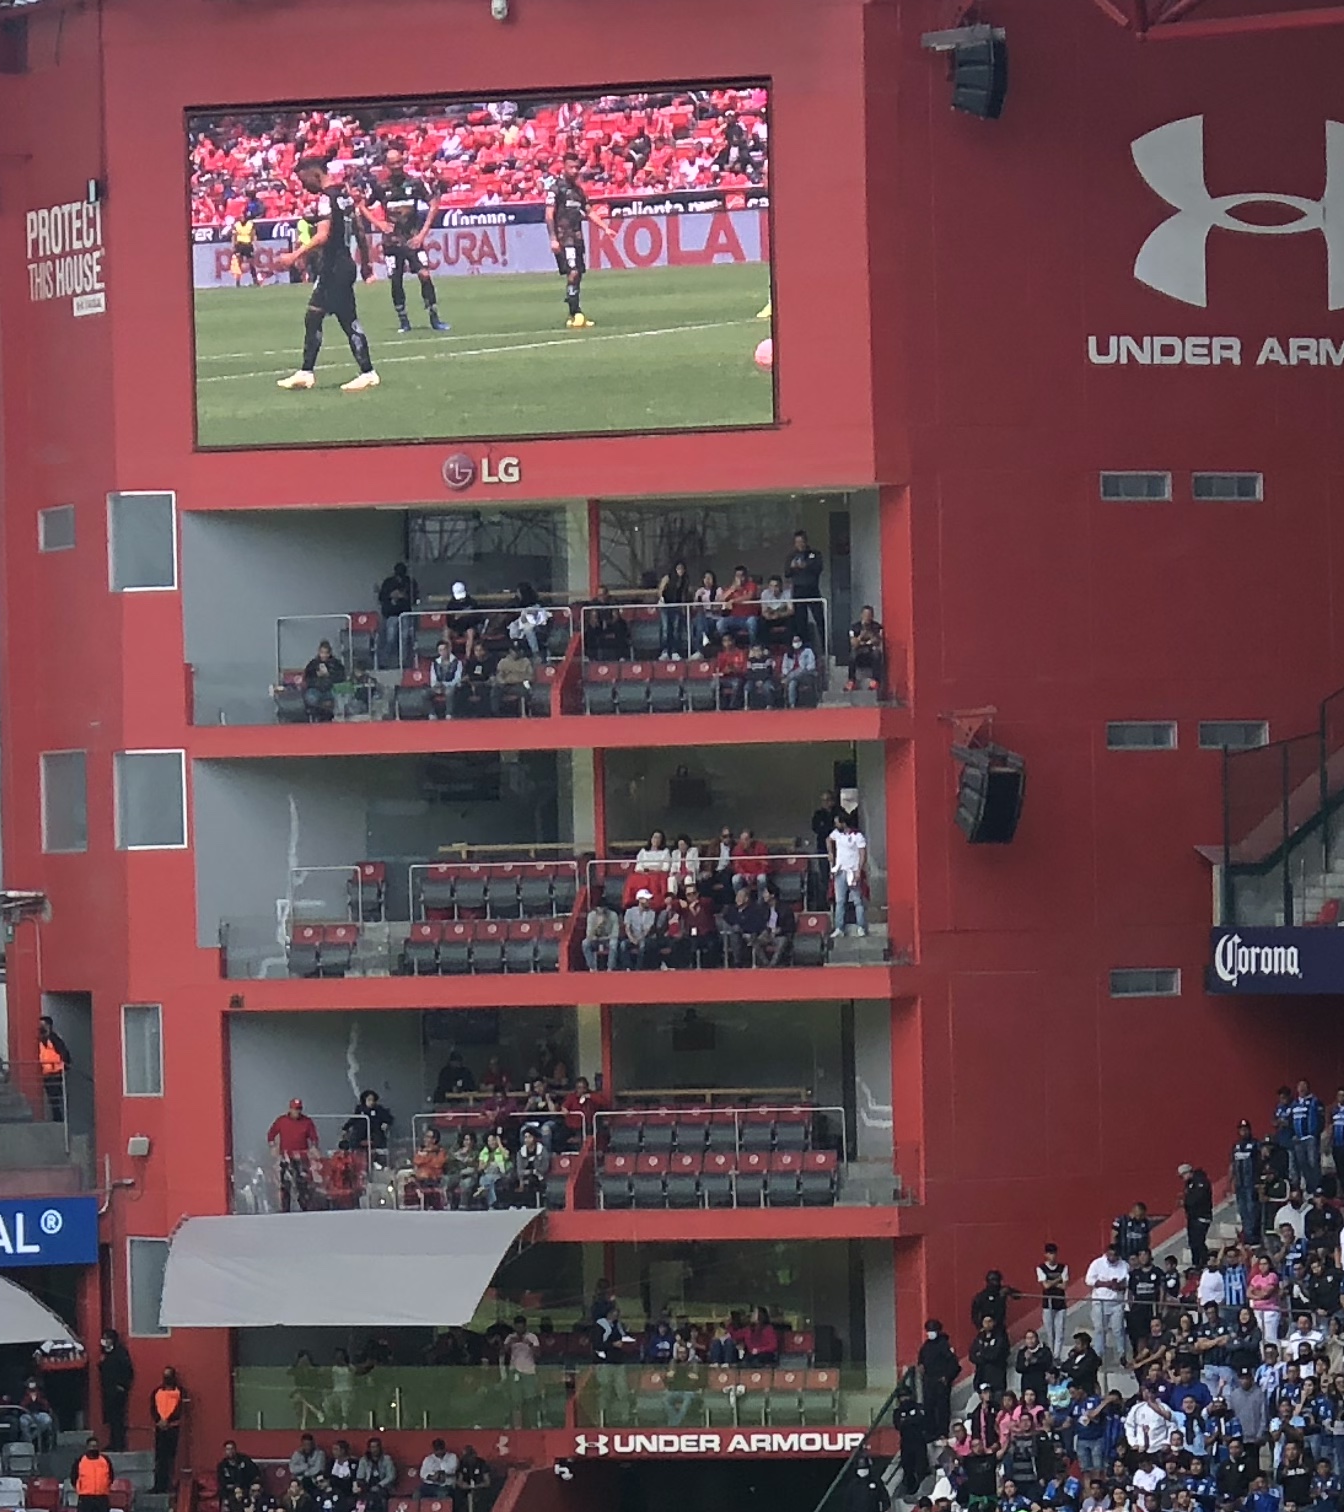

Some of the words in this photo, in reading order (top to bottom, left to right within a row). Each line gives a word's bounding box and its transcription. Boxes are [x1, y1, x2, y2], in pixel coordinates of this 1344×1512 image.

[26, 200, 102, 259] PROTECT
[588, 212, 747, 270] KOLA
[27, 260, 54, 302] THIS
[56, 250, 105, 297] HOUSE
[1087, 335, 1241, 366] UNDER
[481, 456, 520, 484] LG
[1214, 932, 1301, 988] Corona
[613, 1433, 721, 1454] UNDER
[726, 1432, 866, 1453] ARMOUR
